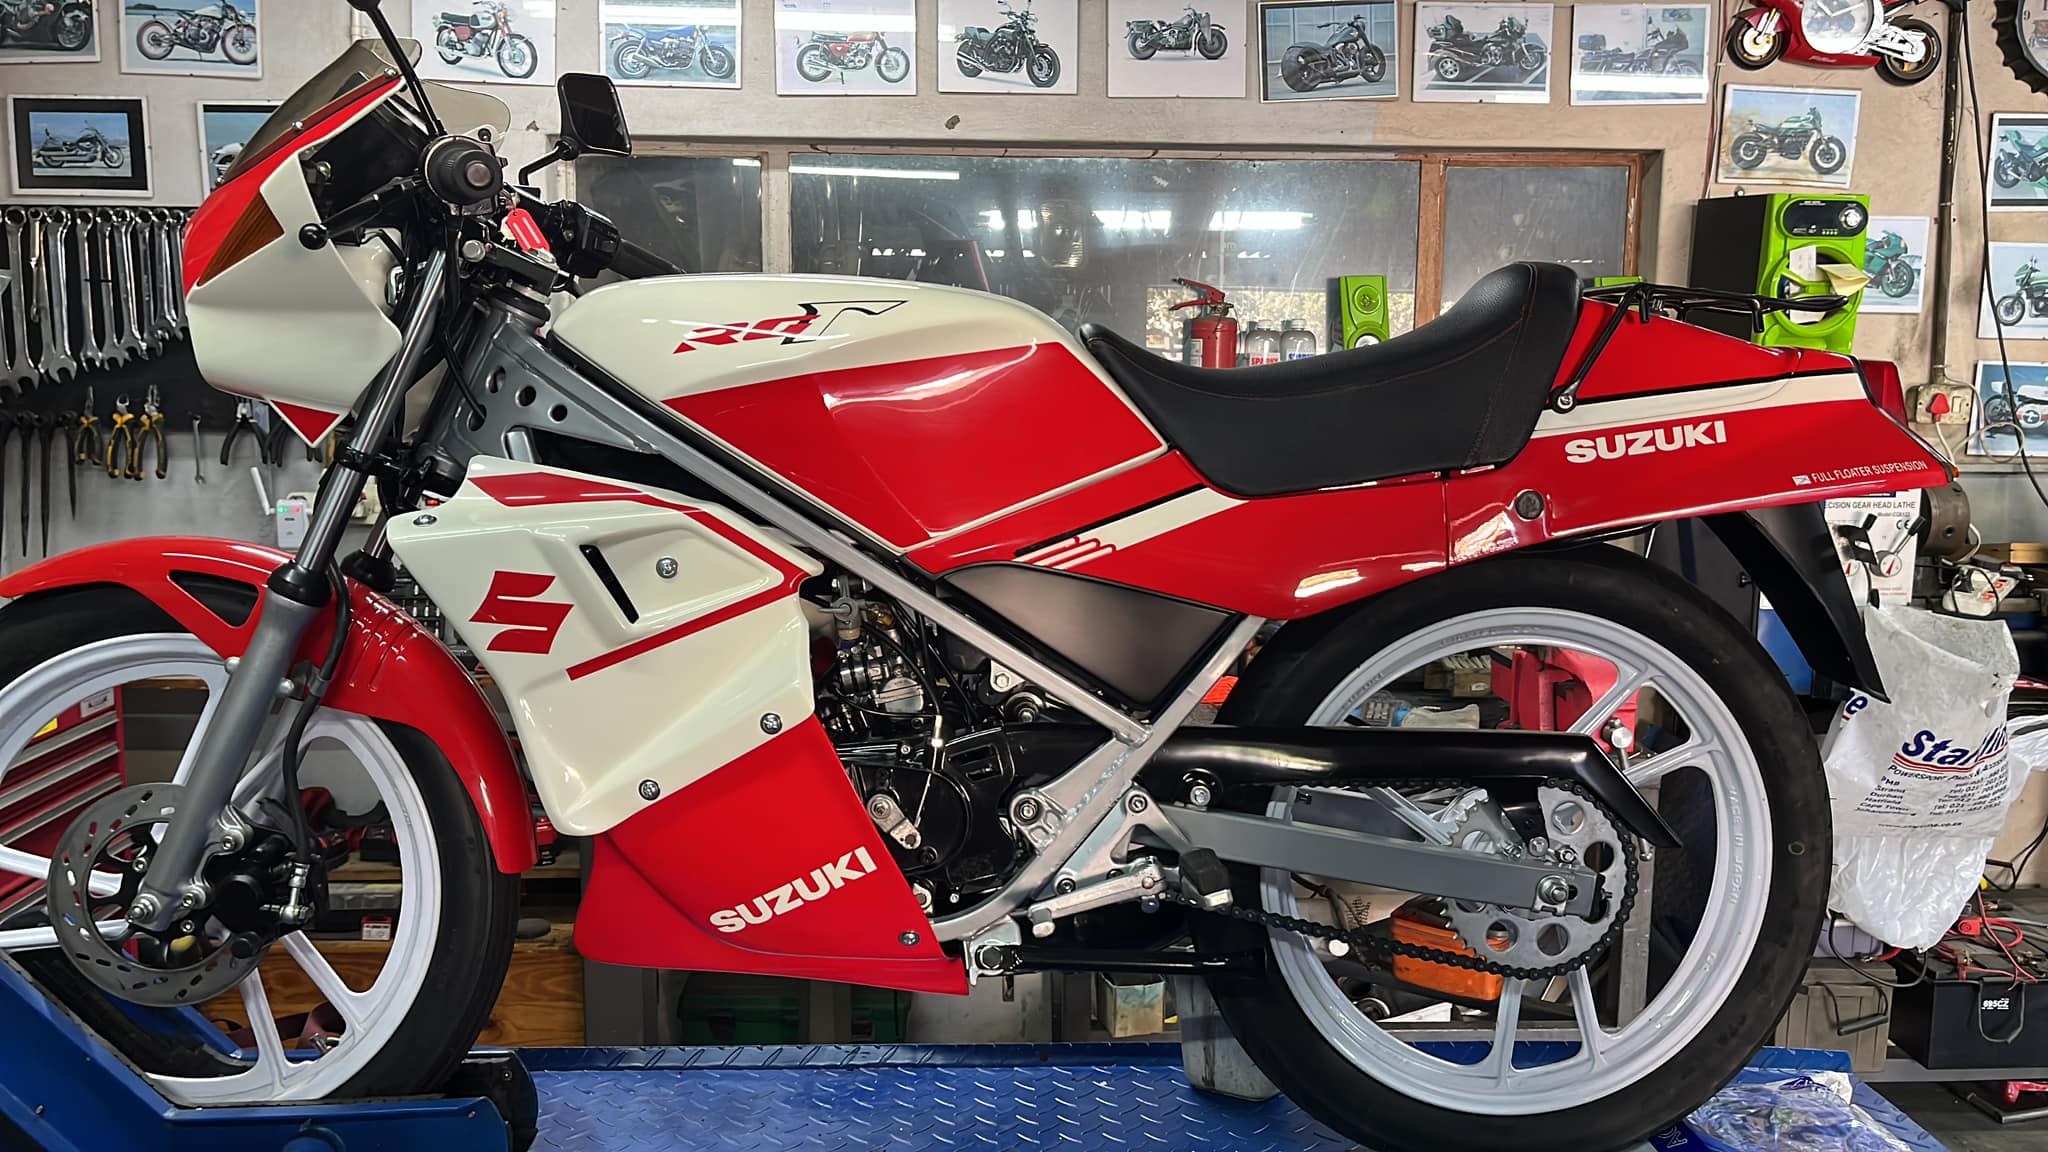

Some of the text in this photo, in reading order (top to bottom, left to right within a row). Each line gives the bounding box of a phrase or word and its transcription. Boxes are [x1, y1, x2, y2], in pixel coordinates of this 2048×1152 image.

[1564, 420, 1727, 464] SUZUKI
[1810, 459, 1929, 483] FULL FLOATER SUSPENSION
[1852, 501, 1872, 510] GEAR
[1873, 501, 1892, 510] HEAD
[1893, 501, 1917, 509] LATHE
[709, 846, 878, 933] SUZUKI
